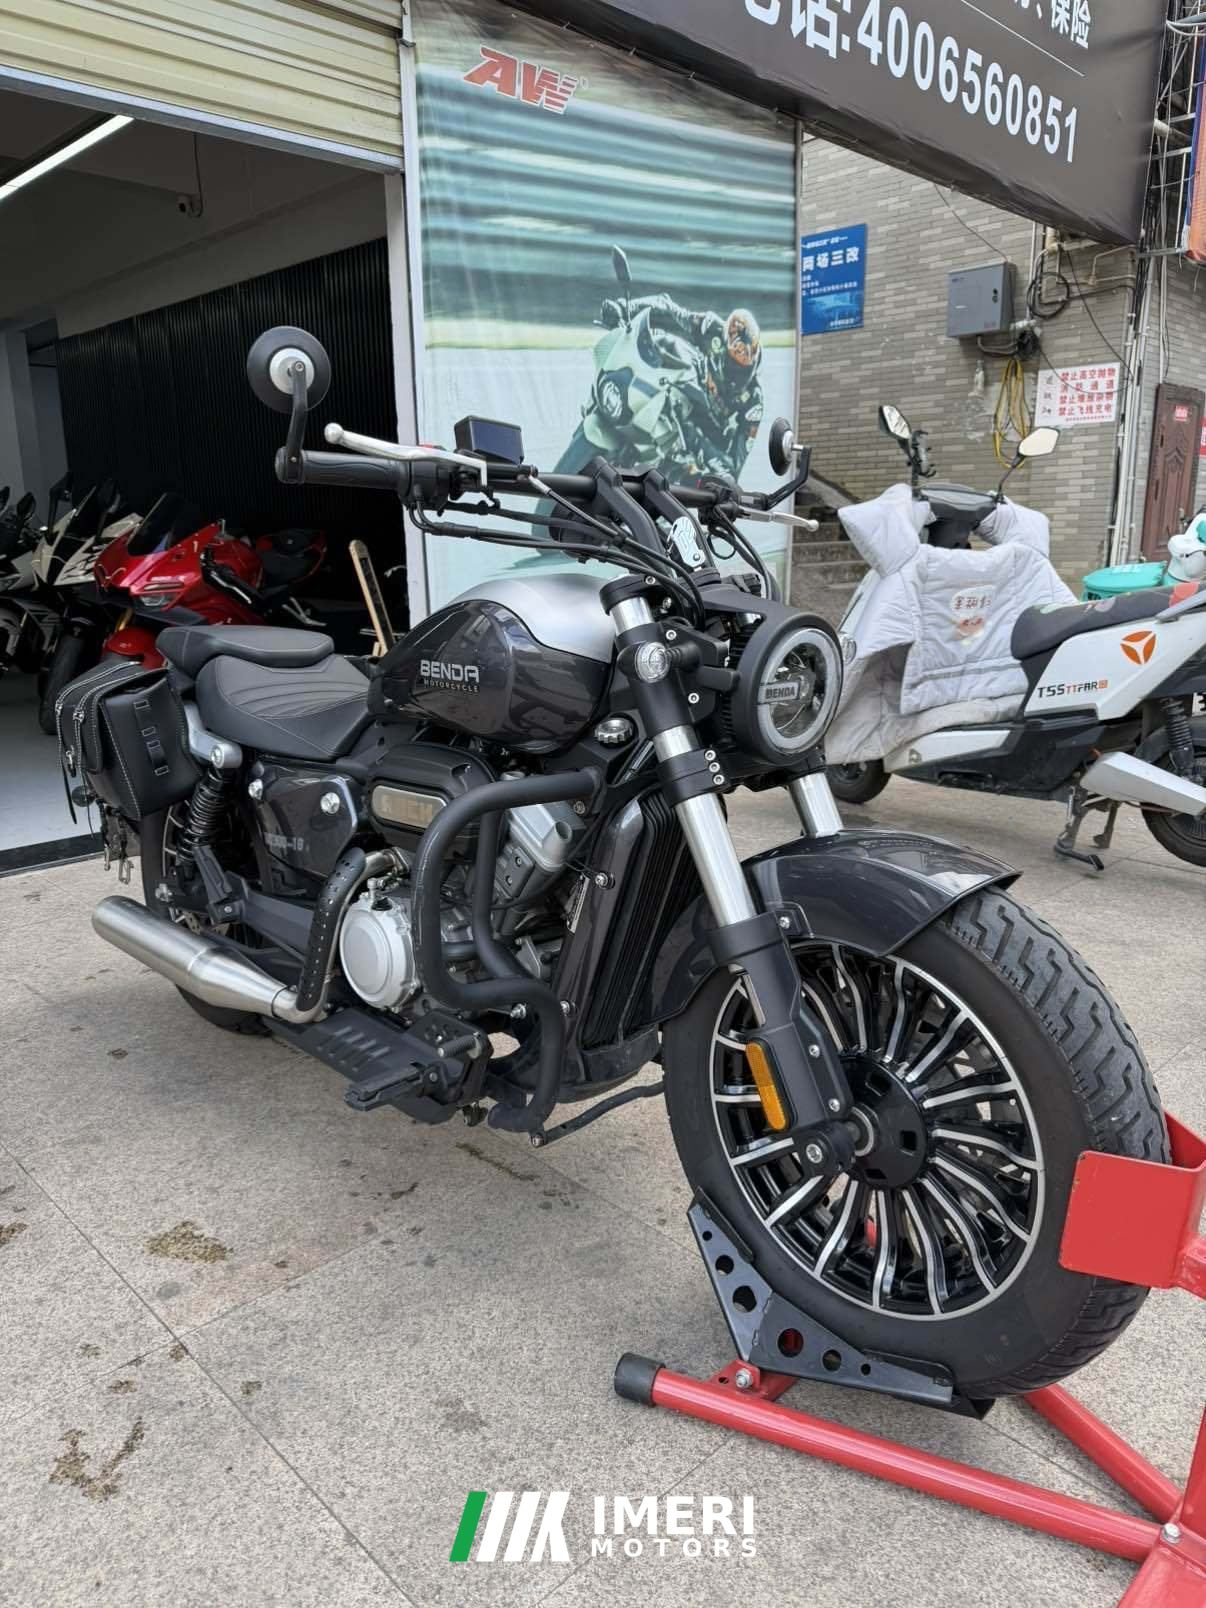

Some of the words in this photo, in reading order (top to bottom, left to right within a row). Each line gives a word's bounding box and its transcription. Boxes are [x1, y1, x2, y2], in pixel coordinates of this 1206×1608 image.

[1014, 0, 1091, 49] 、保险
[420, 659, 480, 683] BENDA
[424, 678, 479, 692] MOTORCYCLE
[765, 687, 795, 699] BENDA
